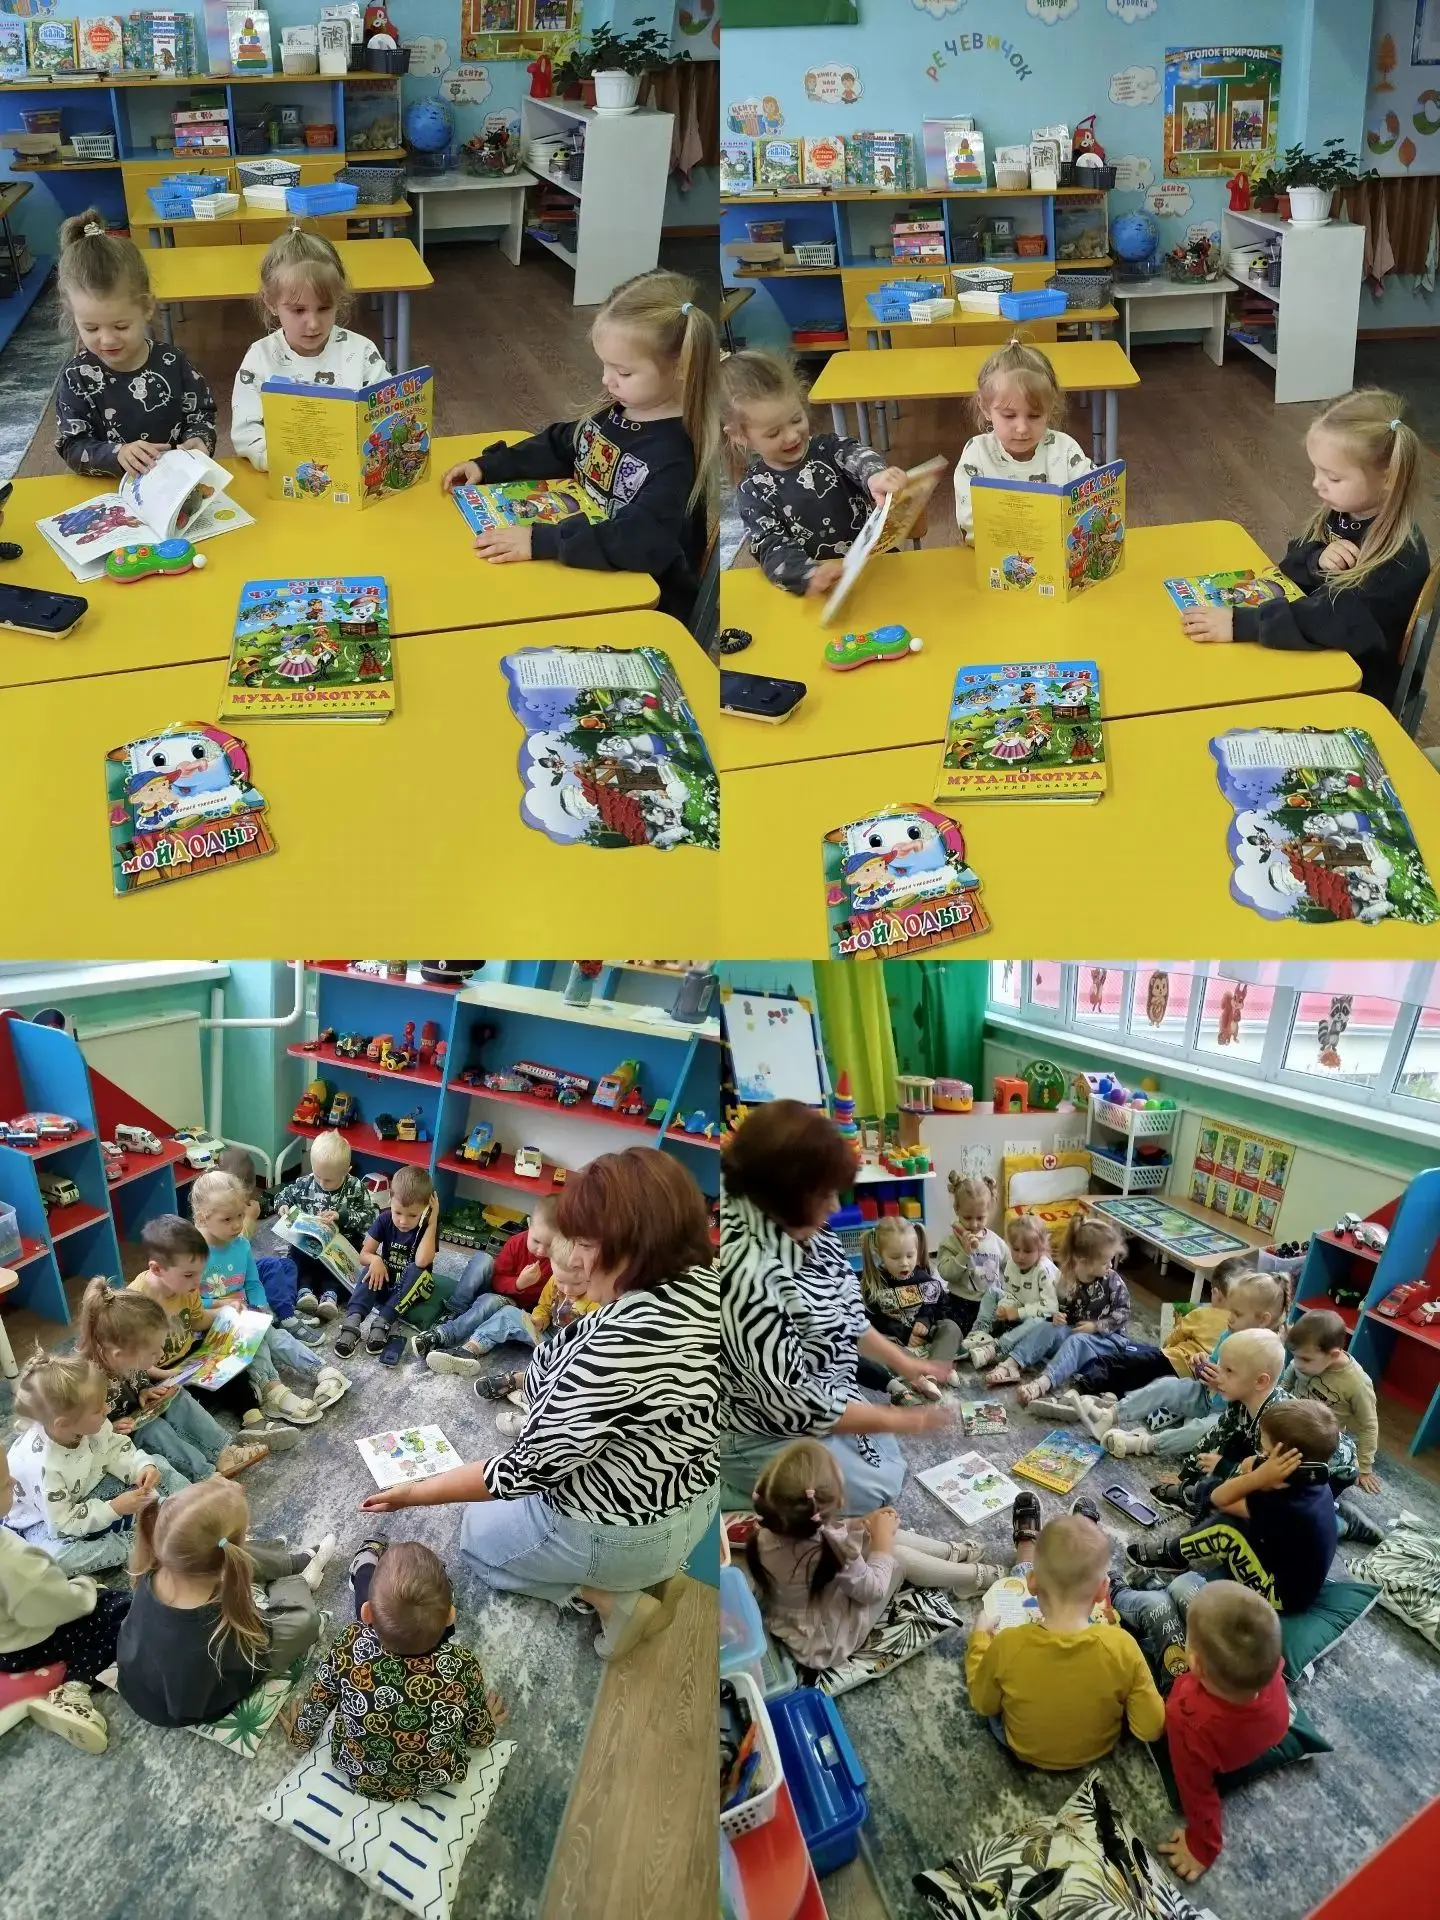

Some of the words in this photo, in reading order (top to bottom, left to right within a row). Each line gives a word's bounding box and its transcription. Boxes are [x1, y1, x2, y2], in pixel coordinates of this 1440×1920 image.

[925, 32, 1033, 83] РЕЧЕВИЧОК
[1184, 48, 1220, 61] УГОЛОК
[1222, 47, 1268, 59] ПРИРОДЫ
[363, 393, 427, 423] СКОРОГОВОРКИ
[608, 408, 641, 431] ELLO
[458, 487, 496, 532] АРМАЛЕЙ
[288, 577, 344, 588] КОРНЕЙ
[248, 585, 380, 600] ЧУКОВСКИЙ
[1001, 662, 1057, 672] КОРНЕЙ
[963, 669, 1092, 684] ЧУКОВСКИЙ
[232, 689, 391, 704] МУХА-ЦОКОТУХА
[947, 770, 1103, 785] МУХА-ЦОКОТУХА
[121, 825, 258, 875] МОЙДОДЫР
[838, 904, 974, 954] МОЙДОДЫР
